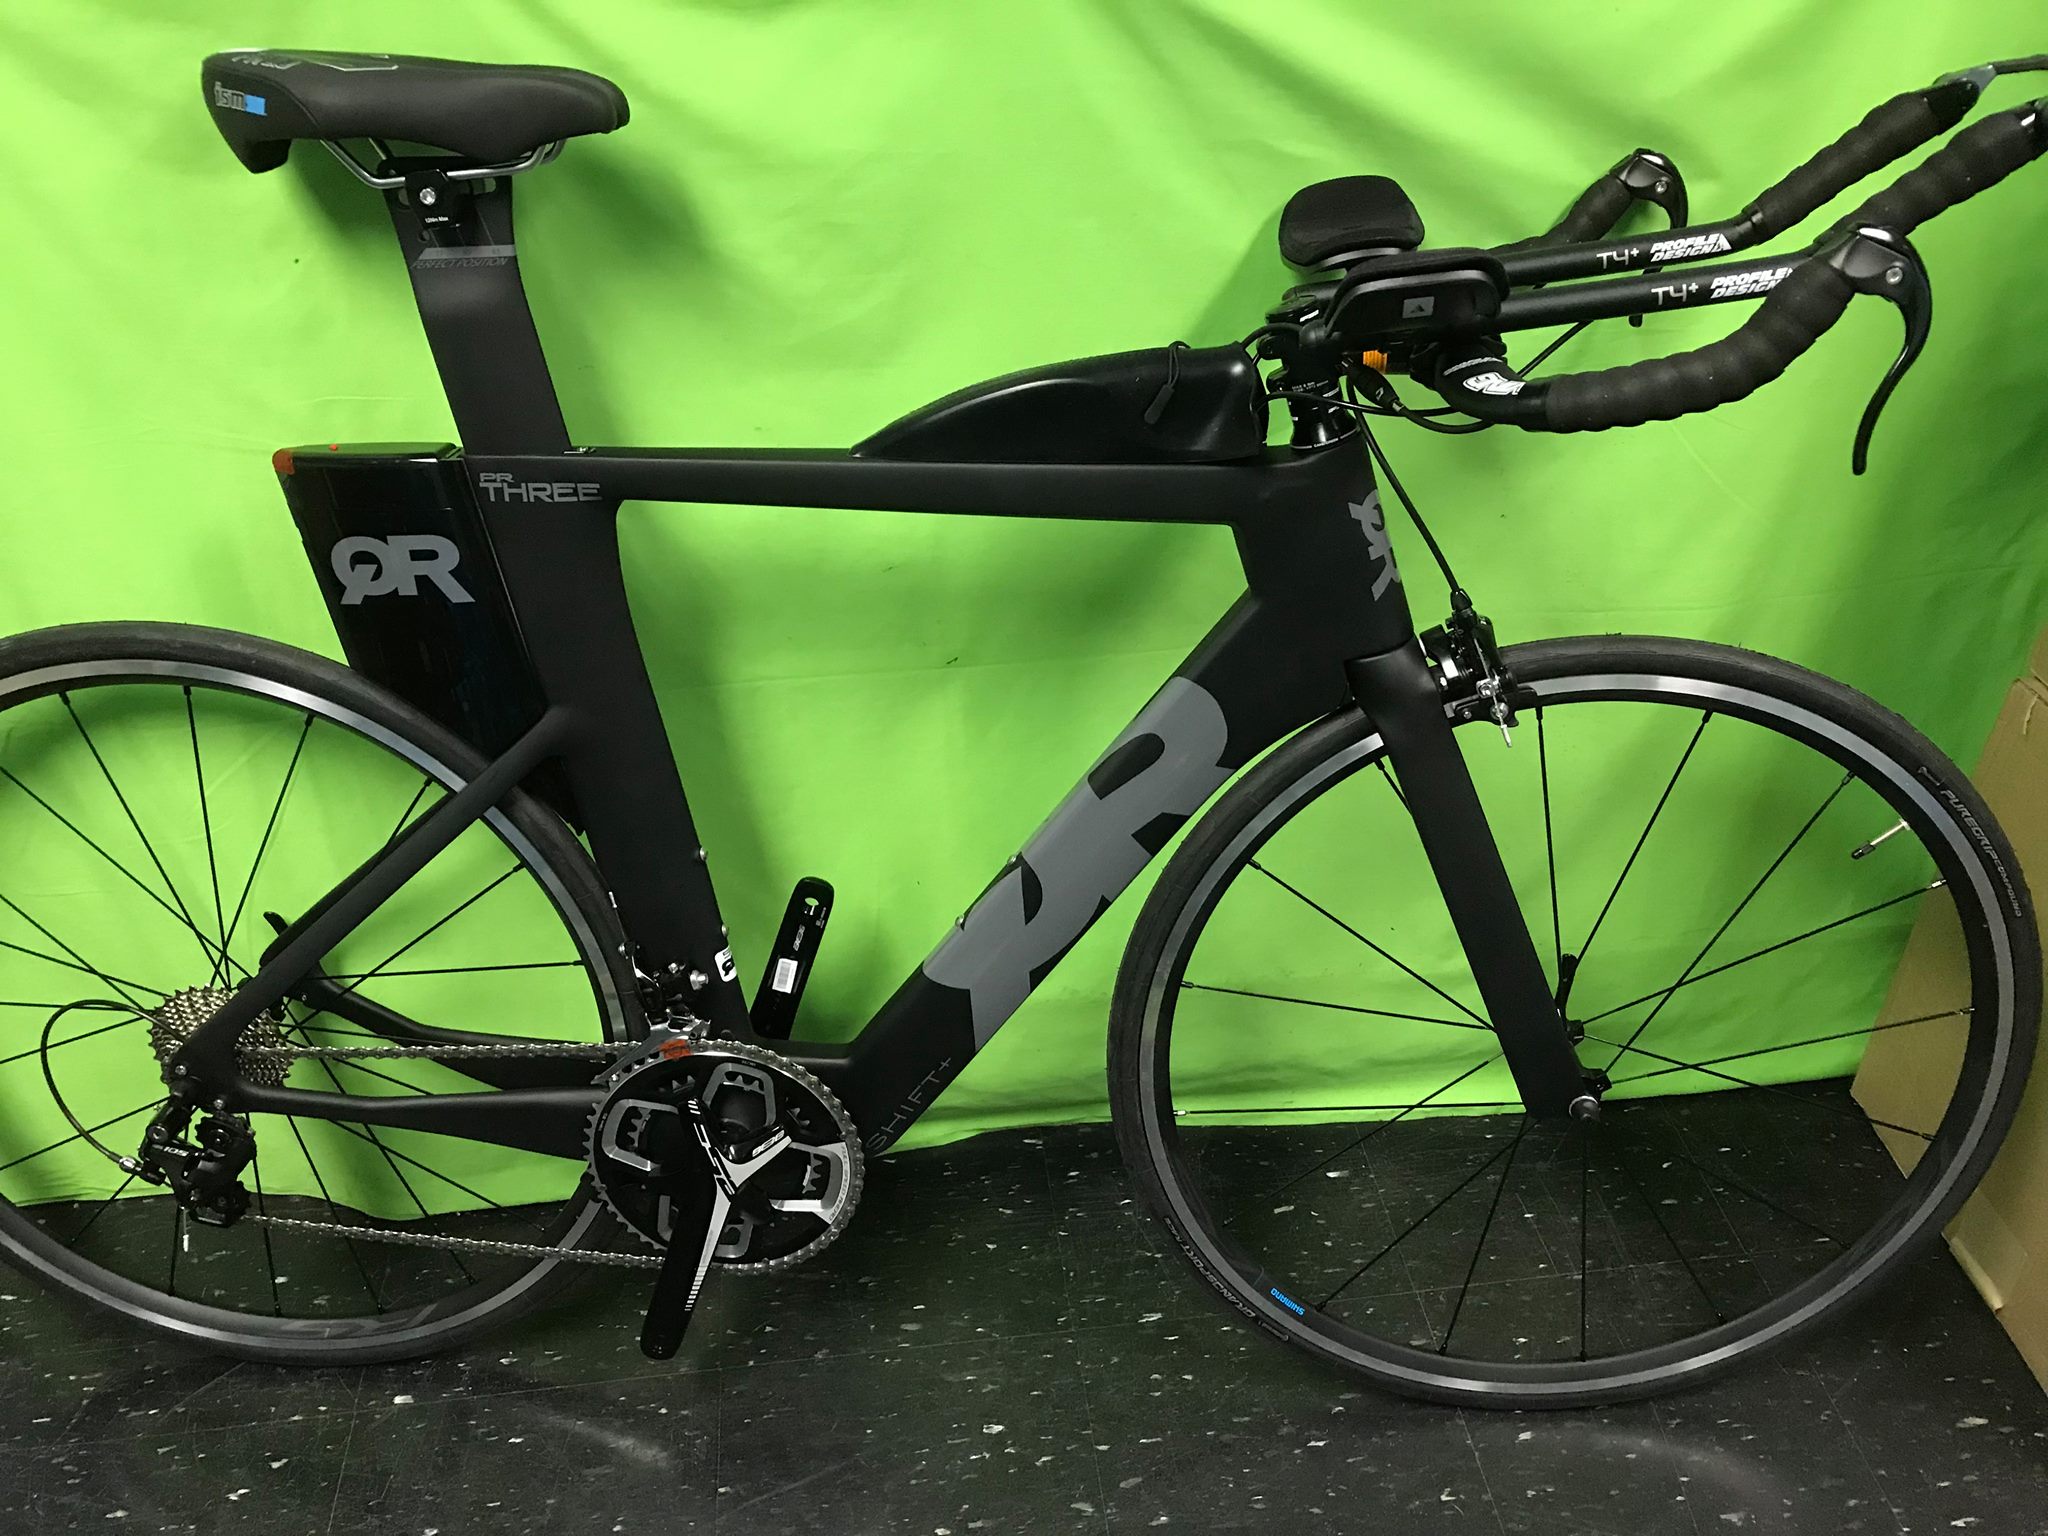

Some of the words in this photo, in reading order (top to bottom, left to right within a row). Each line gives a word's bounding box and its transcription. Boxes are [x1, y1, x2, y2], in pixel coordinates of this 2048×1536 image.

[1651, 233, 1721, 254] PROFILE
[1651, 244, 1717, 262] DESIGN
[1710, 268, 1786, 290] PROFILE
[479, 482, 603, 503] THREE
[330, 534, 476, 606] QR
[163, 1146, 190, 1157] 105
[1269, 1287, 1306, 1316] SHIMANO
